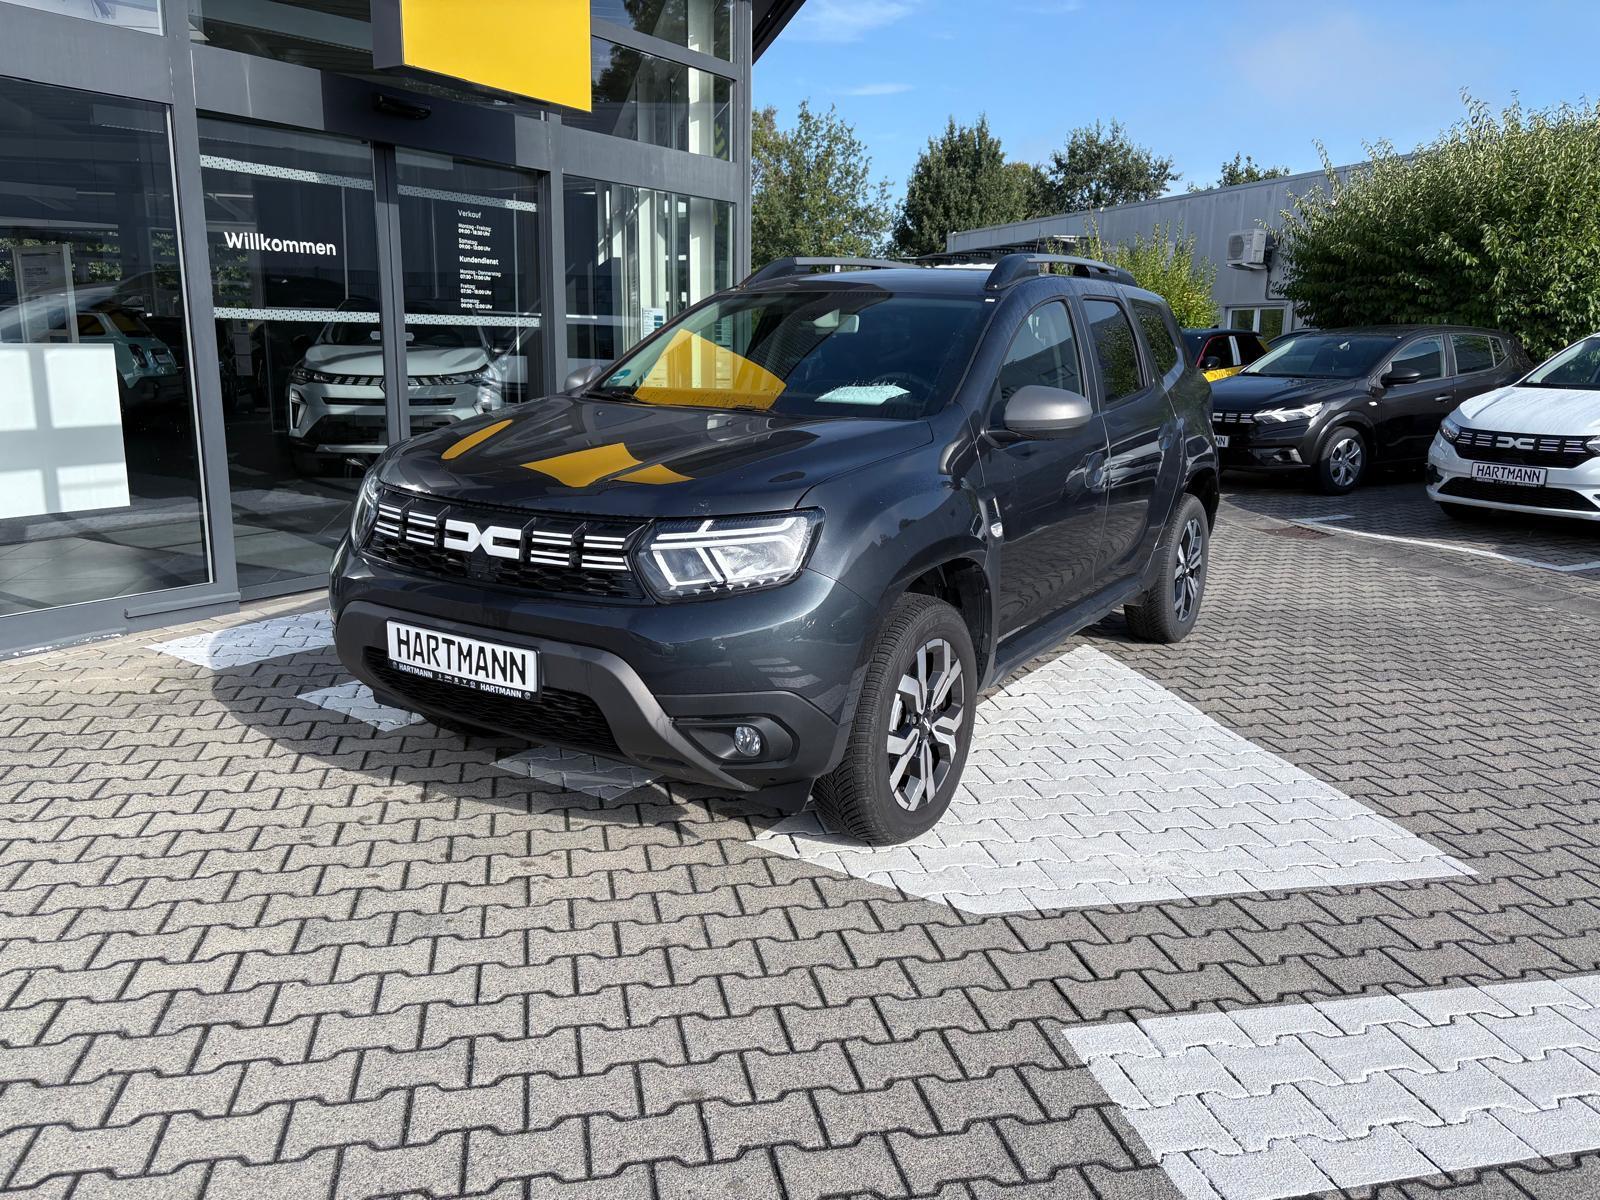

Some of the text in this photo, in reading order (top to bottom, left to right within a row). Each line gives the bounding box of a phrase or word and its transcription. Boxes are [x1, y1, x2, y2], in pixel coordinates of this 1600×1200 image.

[458, 209, 482, 219] Verkauf
[224, 231, 337, 256] Willkommen
[459, 255, 499, 265] Kundendienst
[1476, 464, 1541, 483] HARTMANN
[396, 627, 526, 686] HARTMANN
[398, 663, 433, 679] HARTMANN
[480, 683, 522, 699] HARTMANN
